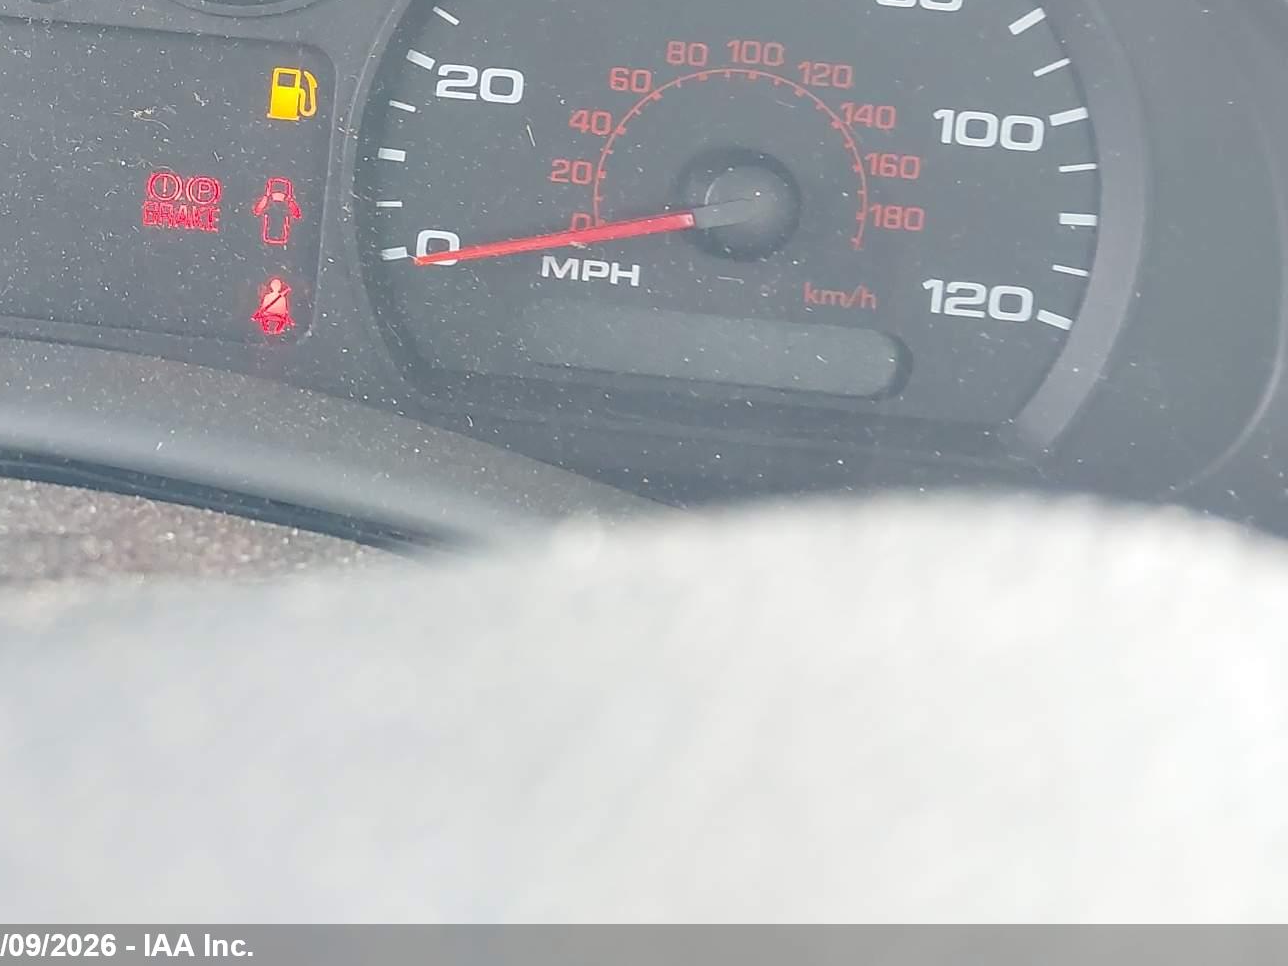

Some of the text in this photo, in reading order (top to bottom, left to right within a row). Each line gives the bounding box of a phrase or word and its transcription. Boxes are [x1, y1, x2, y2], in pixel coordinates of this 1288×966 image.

[667, 41, 708, 67] 80
[727, 40, 785, 67] 100
[435, 64, 524, 104] 20
[610, 67, 653, 93] 60
[797, 61, 855, 90] 120
[569, 109, 611, 135] 40
[840, 102, 897, 130] 140
[933, 109, 1045, 152] 100
[550, 159, 593, 185] 20
[864, 152, 921, 179] 160
[143, 202, 219, 232] BRAKE
[870, 204, 926, 231] 180
[416, 230, 460, 265] 0
[541, 255, 641, 287] MPH
[803, 283, 877, 310] km/h
[923, 280, 1034, 322] 120
